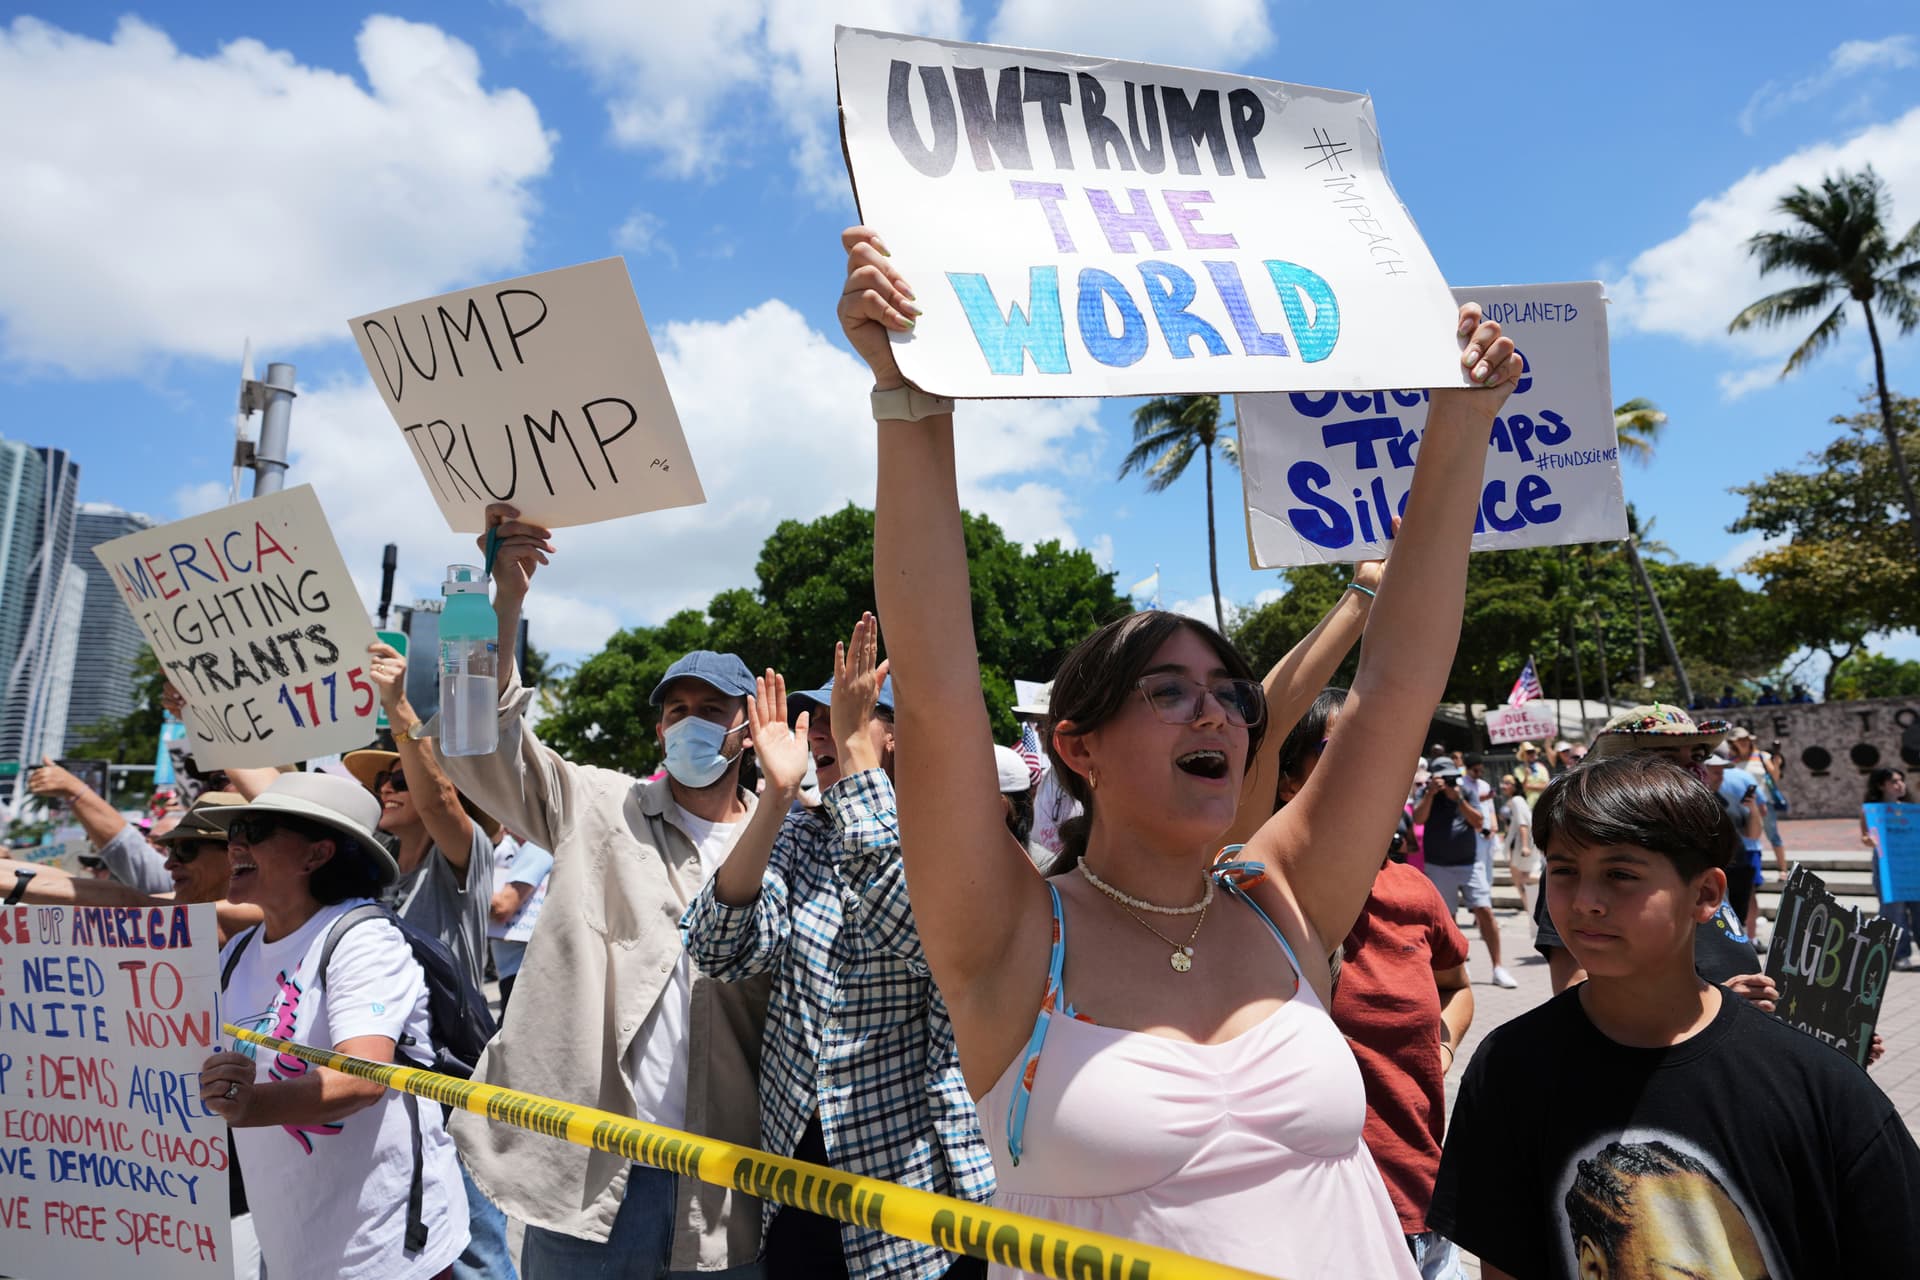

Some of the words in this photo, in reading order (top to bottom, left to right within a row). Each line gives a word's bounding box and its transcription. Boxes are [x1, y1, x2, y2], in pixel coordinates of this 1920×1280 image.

[887, 59, 1266, 180] UNTRUMP
[1010, 180, 1239, 253] THE
[363, 289, 547, 403] DUMP
[945, 260, 1340, 376] WORLD
[404, 398, 637, 503] TRUMP
[1287, 461, 1562, 549] Silce
[144, 569, 330, 653] FIGHTING
[166, 624, 339, 698] TYRANTS
[191, 698, 274, 745] SINCE
[278, 667, 374, 727] 1775
[1490, 723, 1550, 737] PROCESS
[1504, 712, 1529, 724] DUE
[38, 907, 64, 945] UP
[72, 905, 192, 950] AMERICA
[1781, 895, 1888, 1009] LGBTQ
[23, 956, 105, 997] NEED
[118, 961, 183, 1009] TO
[0, 1001, 110, 1043] NITE
[40, 1054, 118, 1108] DEMS
[5, 1110, 134, 1152] ECONOMIC
[141, 1128, 229, 1171] CHAOS
[48, 1148, 199, 1204] DEMOCRACY
[45, 1201, 107, 1241] FREE
[116, 1208, 216, 1262] SPEECH
